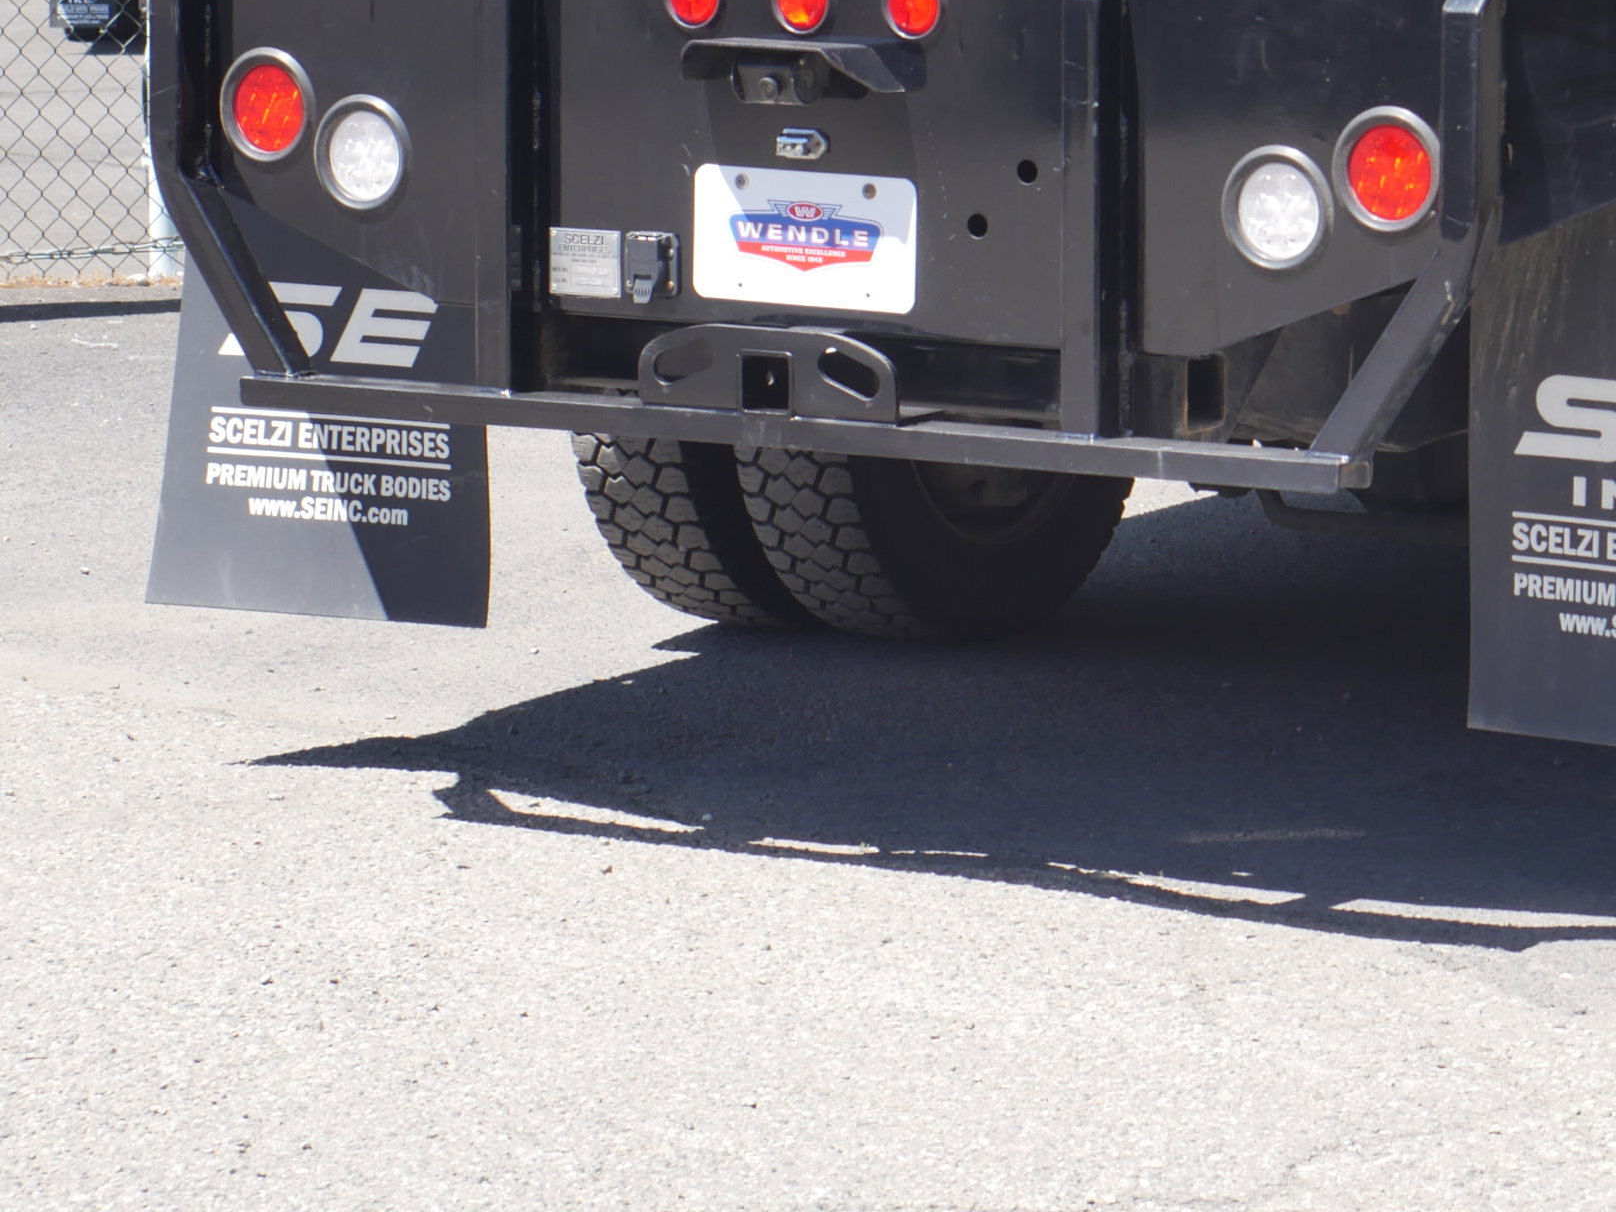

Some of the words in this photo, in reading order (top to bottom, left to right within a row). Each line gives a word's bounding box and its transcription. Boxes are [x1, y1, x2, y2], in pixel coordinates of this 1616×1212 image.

[793, 205, 816, 218] W
[564, 233, 604, 245] SCELZI
[736, 221, 868, 247] WENDLE
[559, 245, 611, 254] ENTERPRISES
[761, 245, 803, 254] AUTOMOTIVE
[804, 248, 846, 258] EXCELLENCE
[786, 254, 806, 263] SINCE
[208, 416, 293, 448] SCELZI
[298, 421, 450, 459] ENTERPRISES
[206, 462, 307, 492] PREMIUM
[311, 468, 377, 496] TRUCK
[381, 474, 451, 502] BODIES
[248, 497, 408, 526] www.SEINC.com
[1512, 522, 1600, 558] SCELZI
[1513, 572, 1616, 608] PREMIUM
